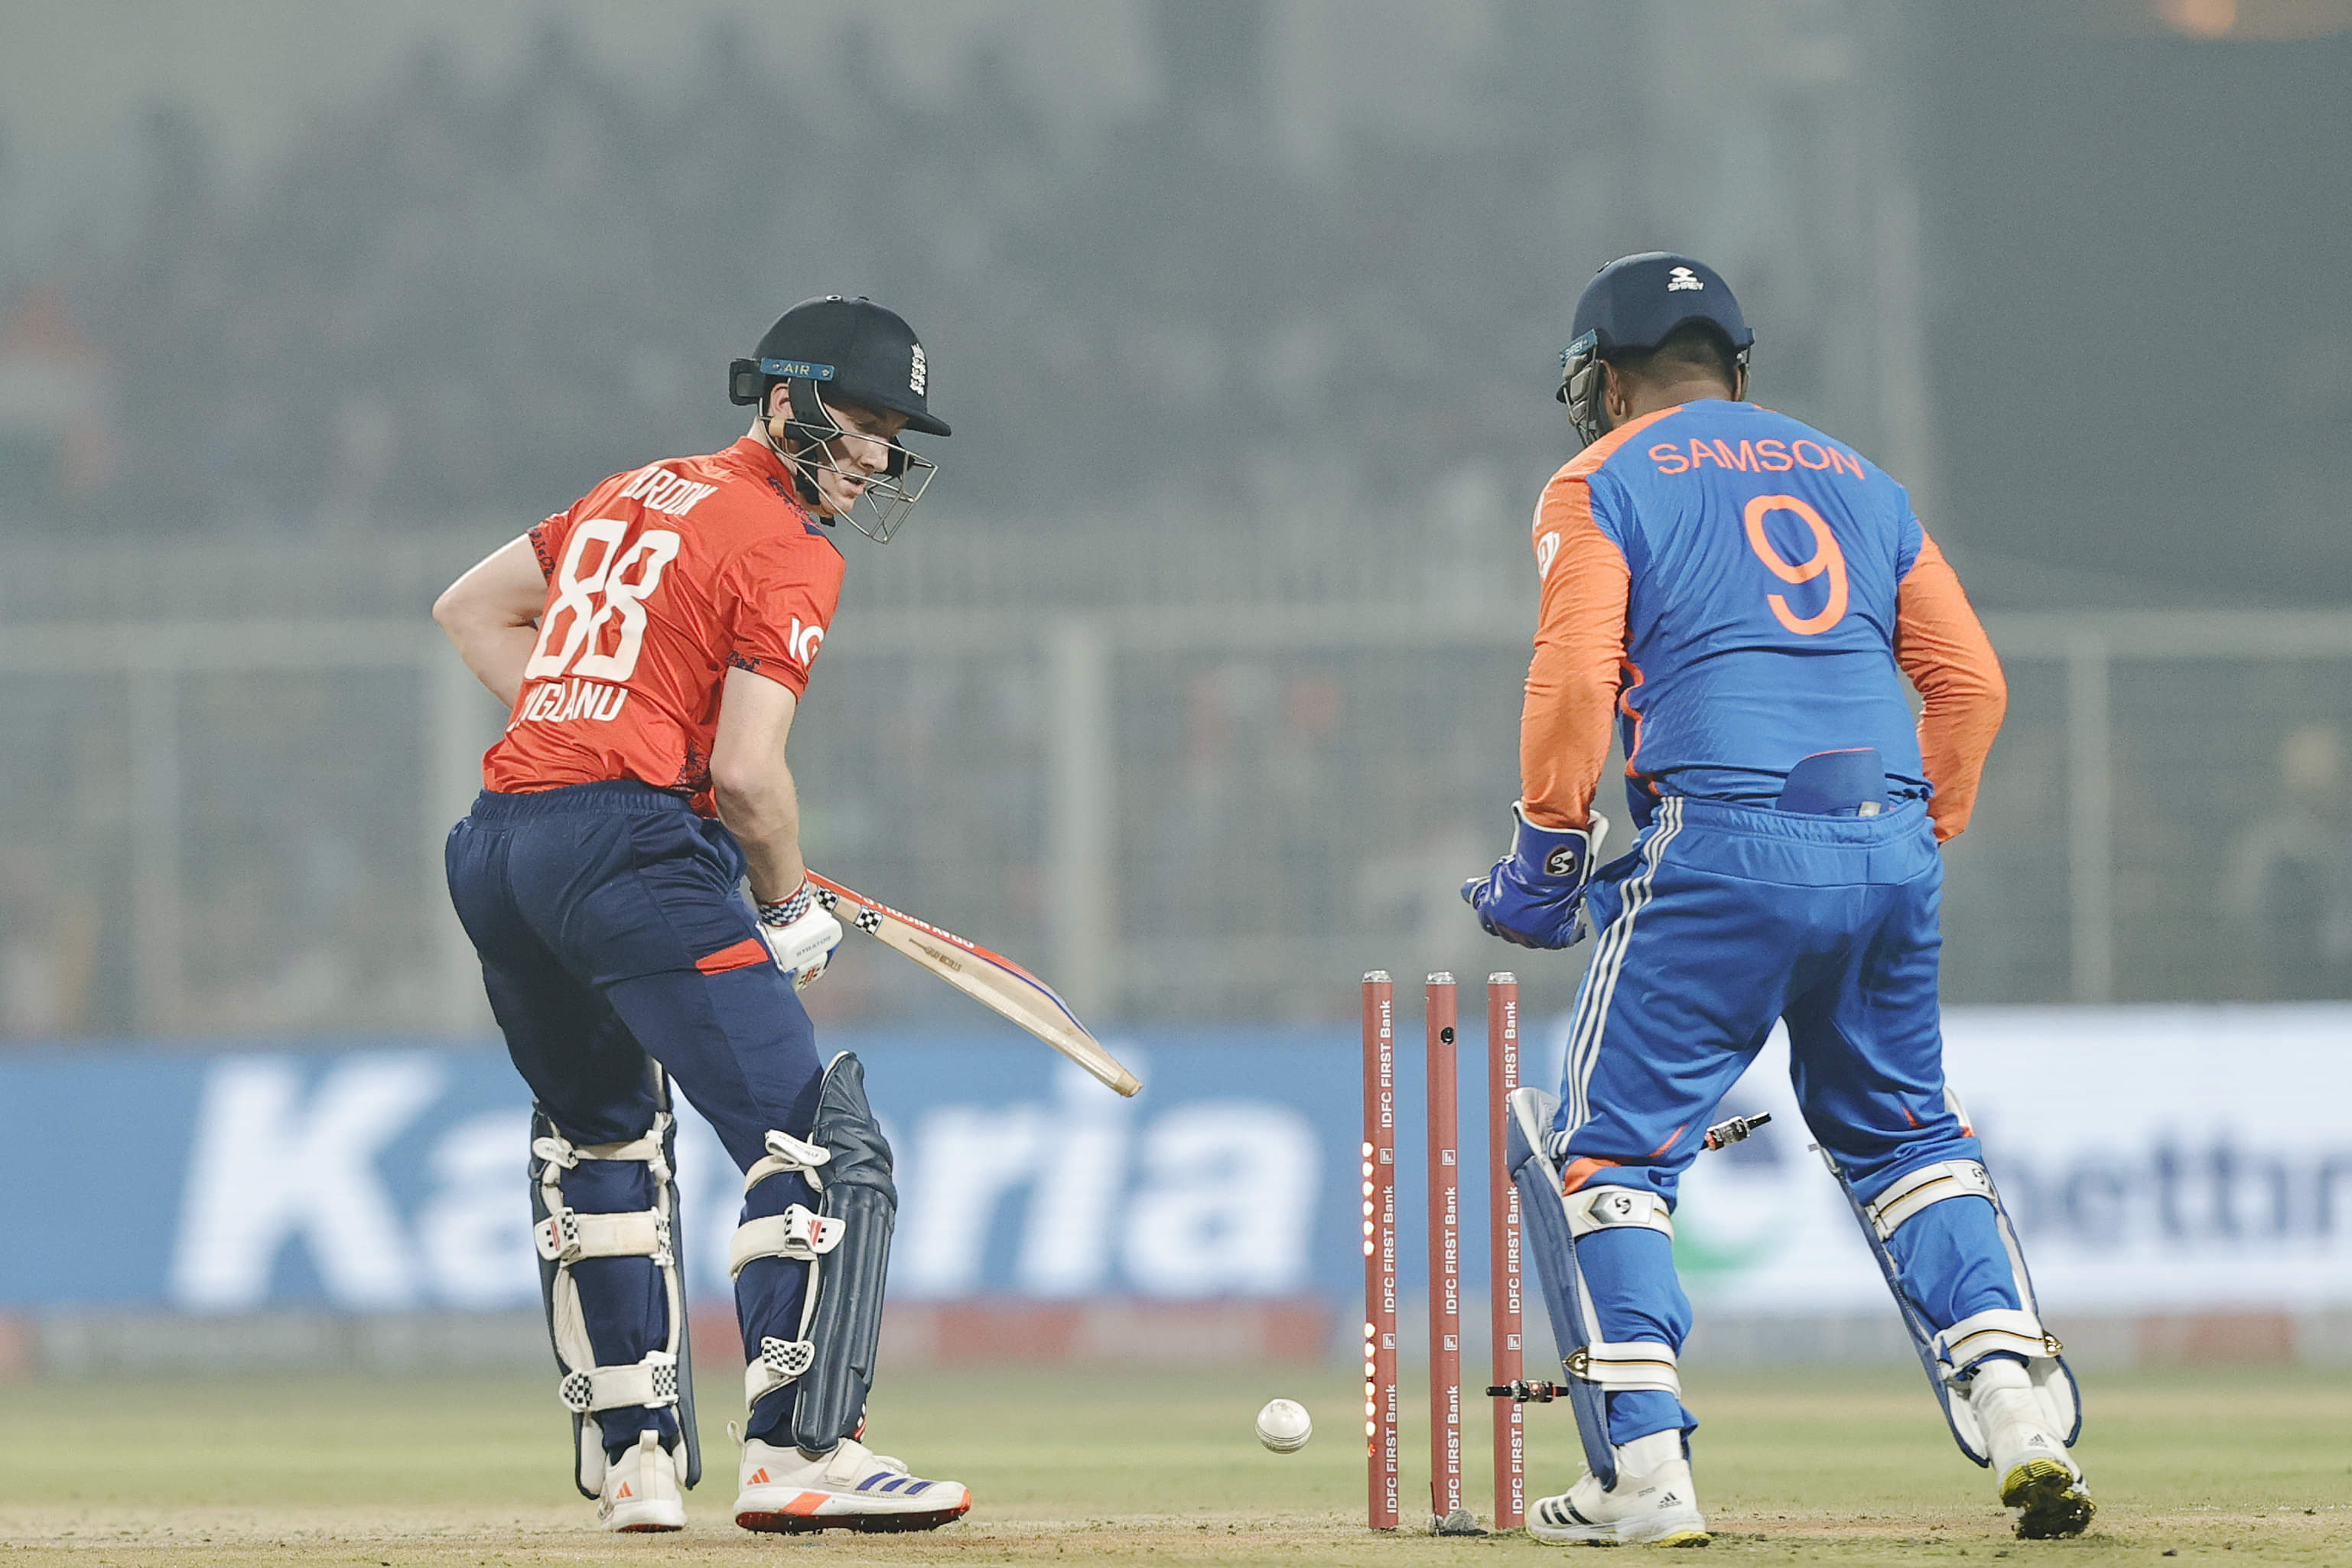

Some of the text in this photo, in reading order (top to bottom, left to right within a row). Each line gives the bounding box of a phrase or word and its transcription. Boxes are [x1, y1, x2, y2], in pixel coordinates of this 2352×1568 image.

[783, 363, 811, 376] AIR
[620, 466, 720, 516] BROOK
[1648, 438, 1866, 480] SAMSON
[524, 518, 682, 683] 88
[1743, 494, 1849, 636] 9
[1379, 1000, 1393, 1128] IDFC FIRST Bank
[1505, 1001, 1516, 1039] Bank
[1505, 1043, 1517, 1088] FIRST
[170, 1045, 1325, 1313] Karia
[1383, 1186, 1395, 1313] IDFC FIRST Bank
[1444, 1186, 1458, 1316] IDFC FIRST Bank
[1507, 1186, 1520, 1314] IDFC FIRST Bank
[1385, 1384, 1397, 1513] IDFC FIRST Bank
[1446, 1385, 1459, 1514] DFC FIRST Bank
[1511, 1404, 1523, 1514] IDFC FIRST Ba
